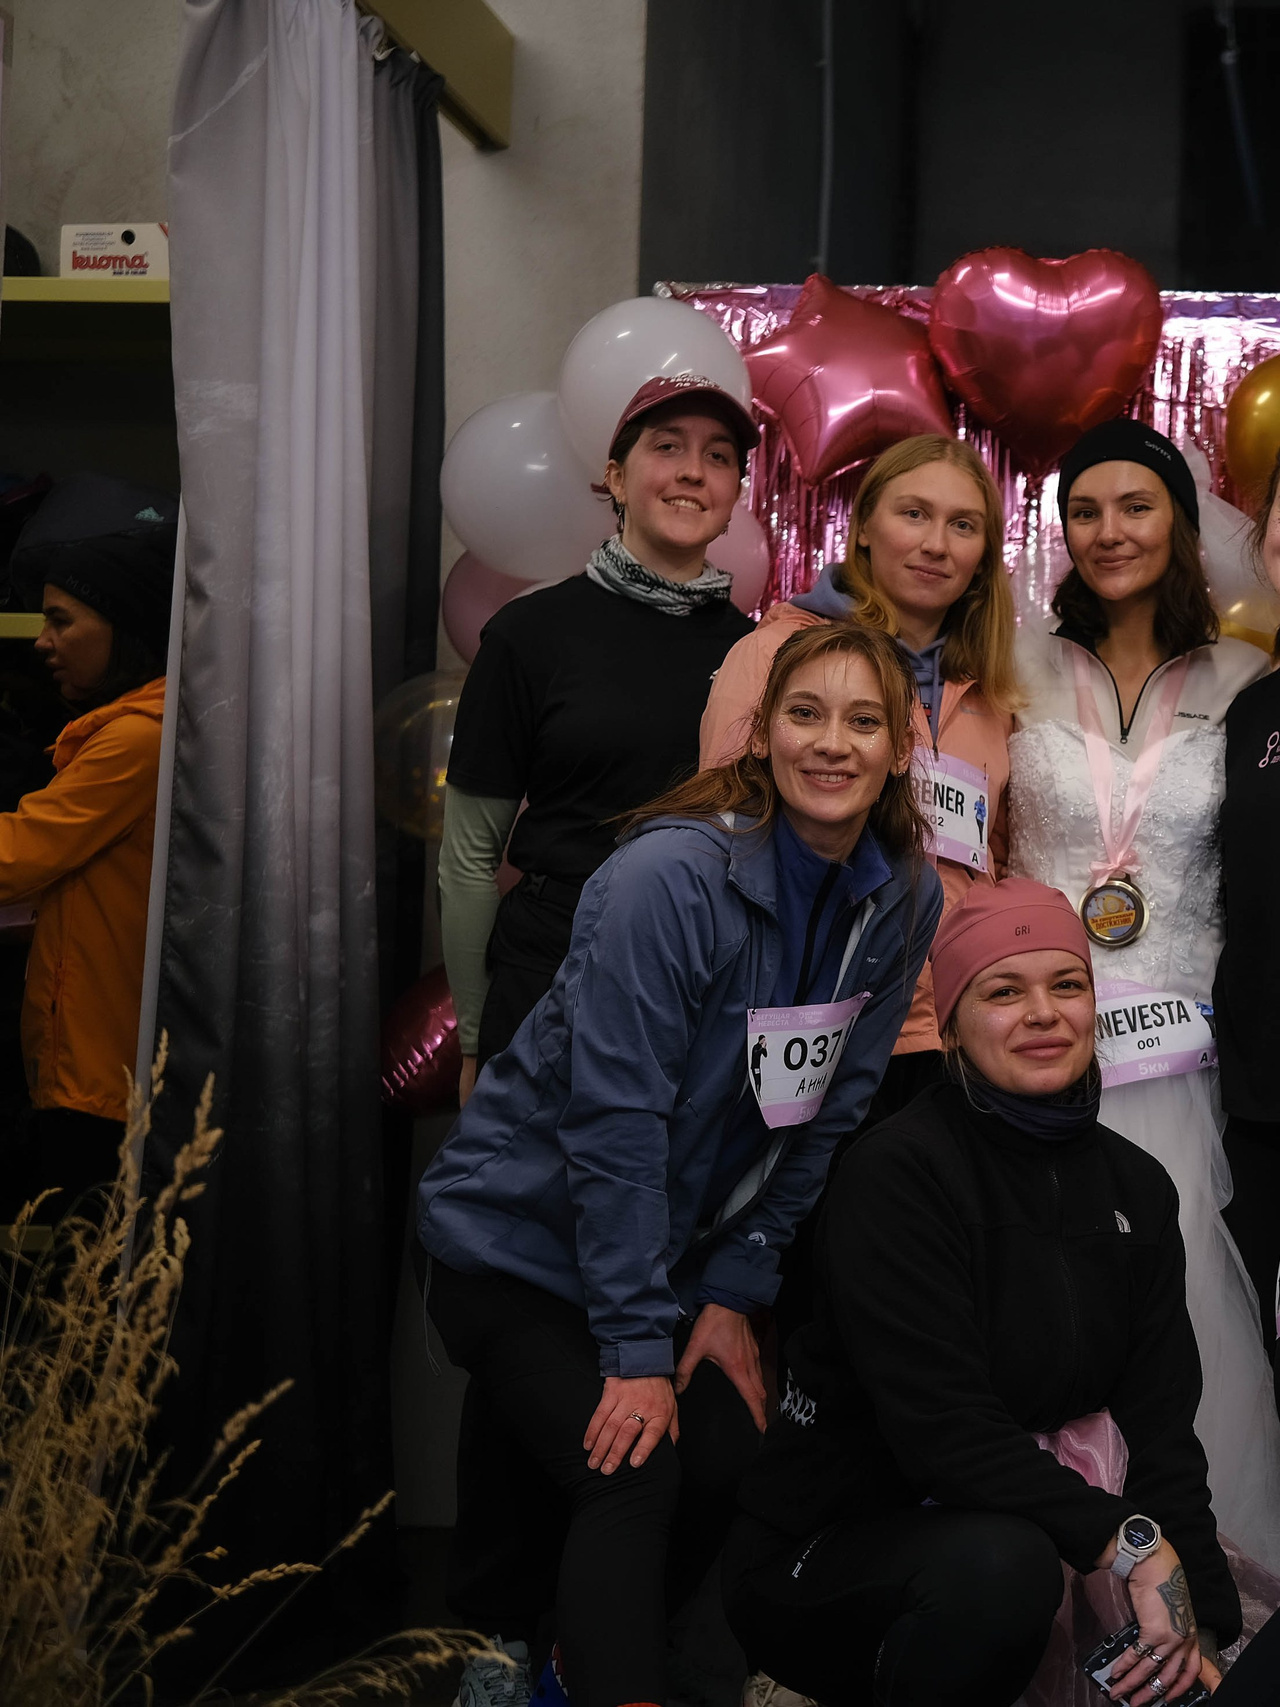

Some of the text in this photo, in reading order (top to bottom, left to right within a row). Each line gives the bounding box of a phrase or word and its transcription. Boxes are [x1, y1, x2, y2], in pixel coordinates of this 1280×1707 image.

[72, 250, 149, 270] kuoma
[910, 777, 965, 817] RENER
[1096, 1000, 1192, 1040] NEVESTA
[783, 1029, 843, 1071] 037
[1137, 1036, 1161, 1050] 001
